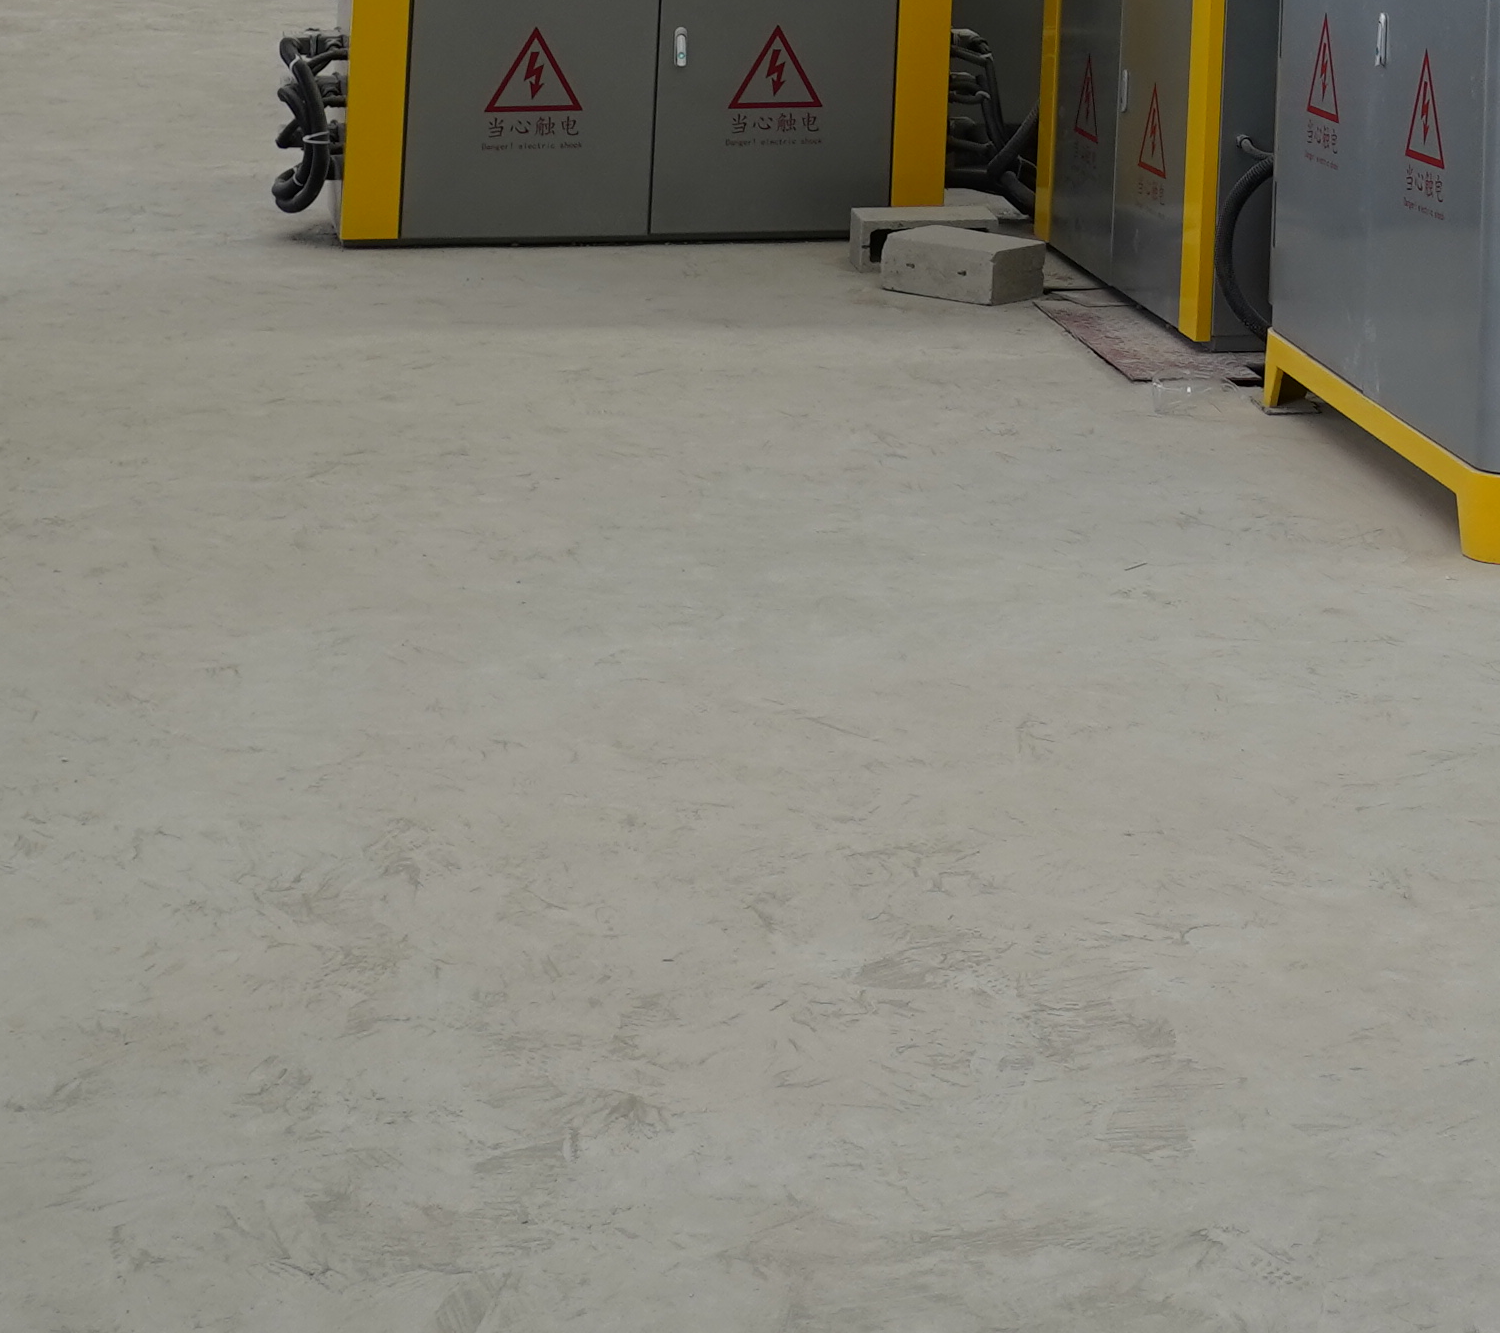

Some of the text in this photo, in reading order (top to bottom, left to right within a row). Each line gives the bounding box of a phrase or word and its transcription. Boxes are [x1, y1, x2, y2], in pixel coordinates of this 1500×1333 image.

[487, 115, 580, 138] 当心触电
[731, 112, 820, 134] 当心触电
[518, 142, 555, 150] electric
